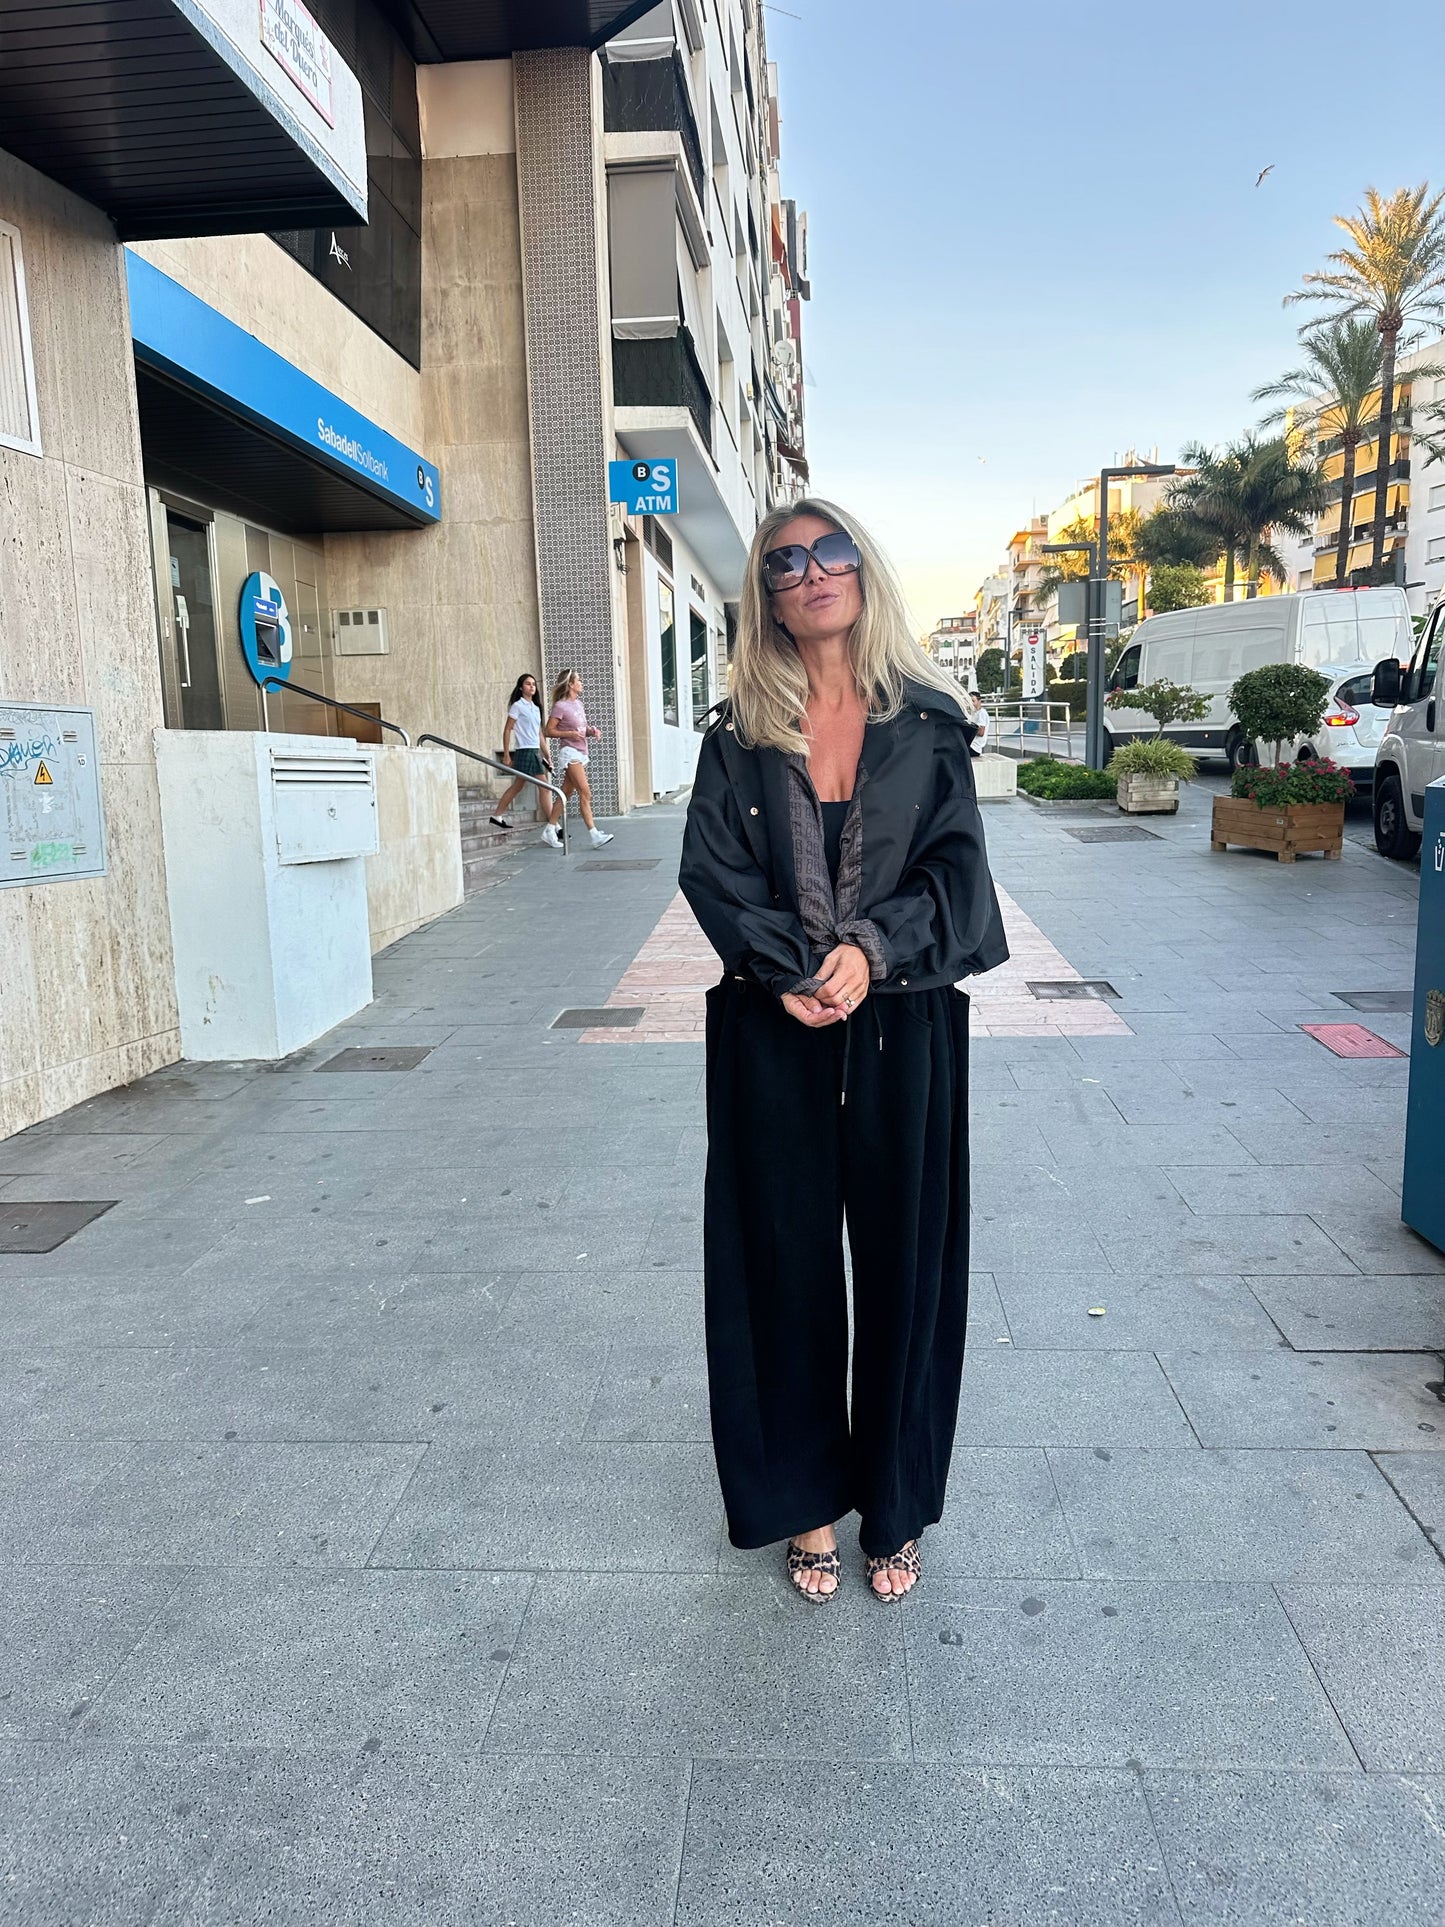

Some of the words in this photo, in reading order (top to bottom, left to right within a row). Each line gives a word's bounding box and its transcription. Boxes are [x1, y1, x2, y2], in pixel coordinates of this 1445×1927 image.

[274, 21, 289, 53] del
[290, 38, 318, 87] Duero
[635, 495, 671, 511] ATM
